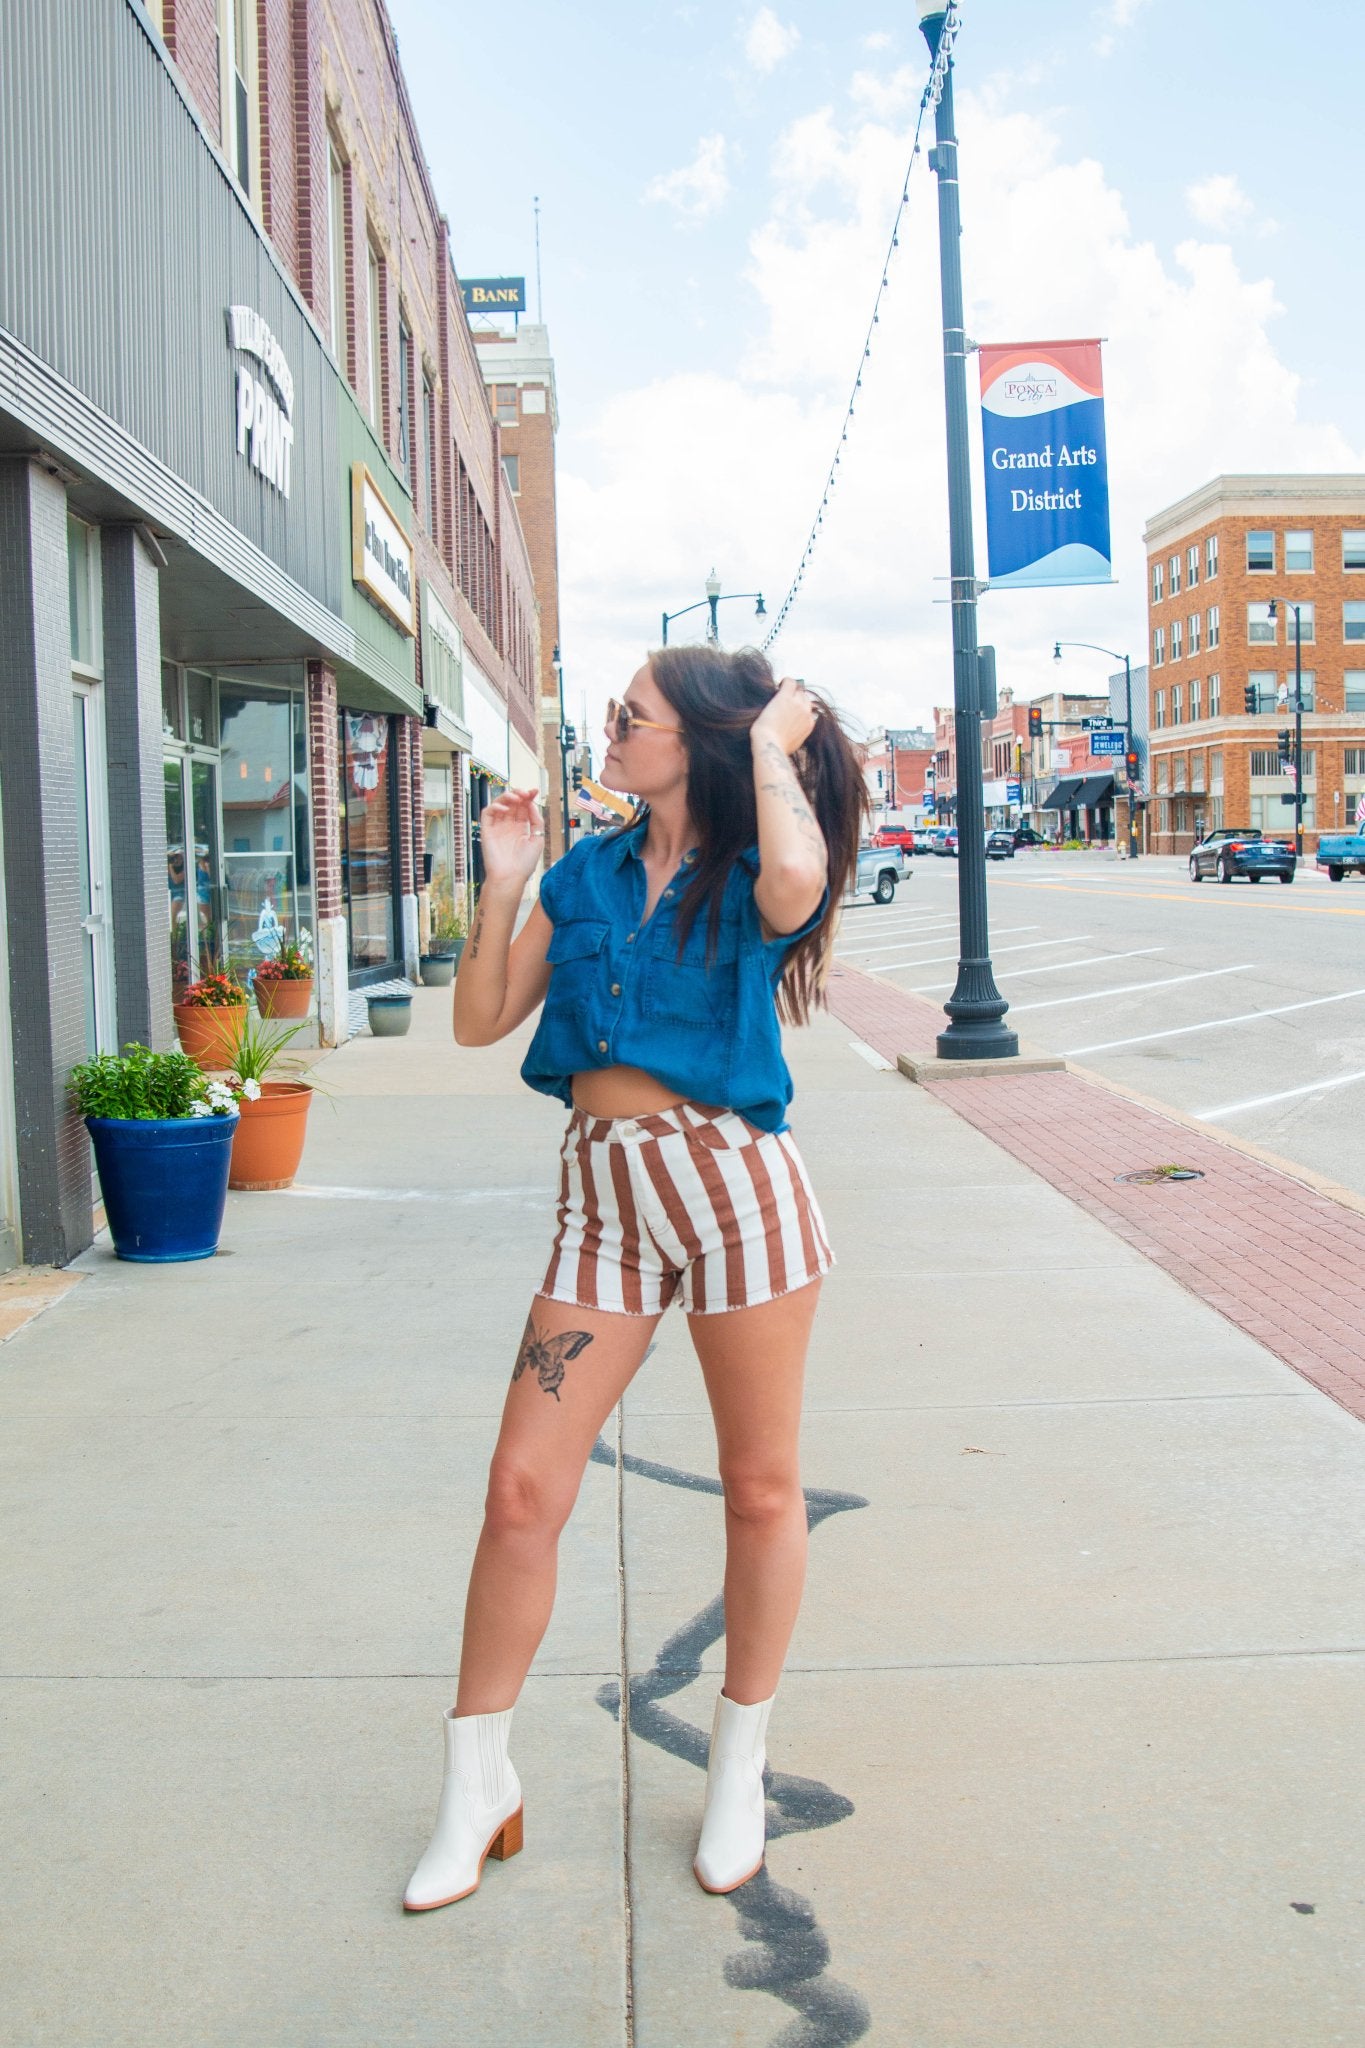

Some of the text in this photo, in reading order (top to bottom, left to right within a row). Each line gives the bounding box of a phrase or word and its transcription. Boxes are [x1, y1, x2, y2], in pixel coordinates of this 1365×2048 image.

[472, 287, 519, 303] BANK
[1008, 383, 1054, 395] PONCA
[237, 365, 294, 500] PRINT
[991, 444, 1097, 470] Grand Arts
[1010, 487, 1082, 512] District
[1088, 719, 1107, 727] Third
